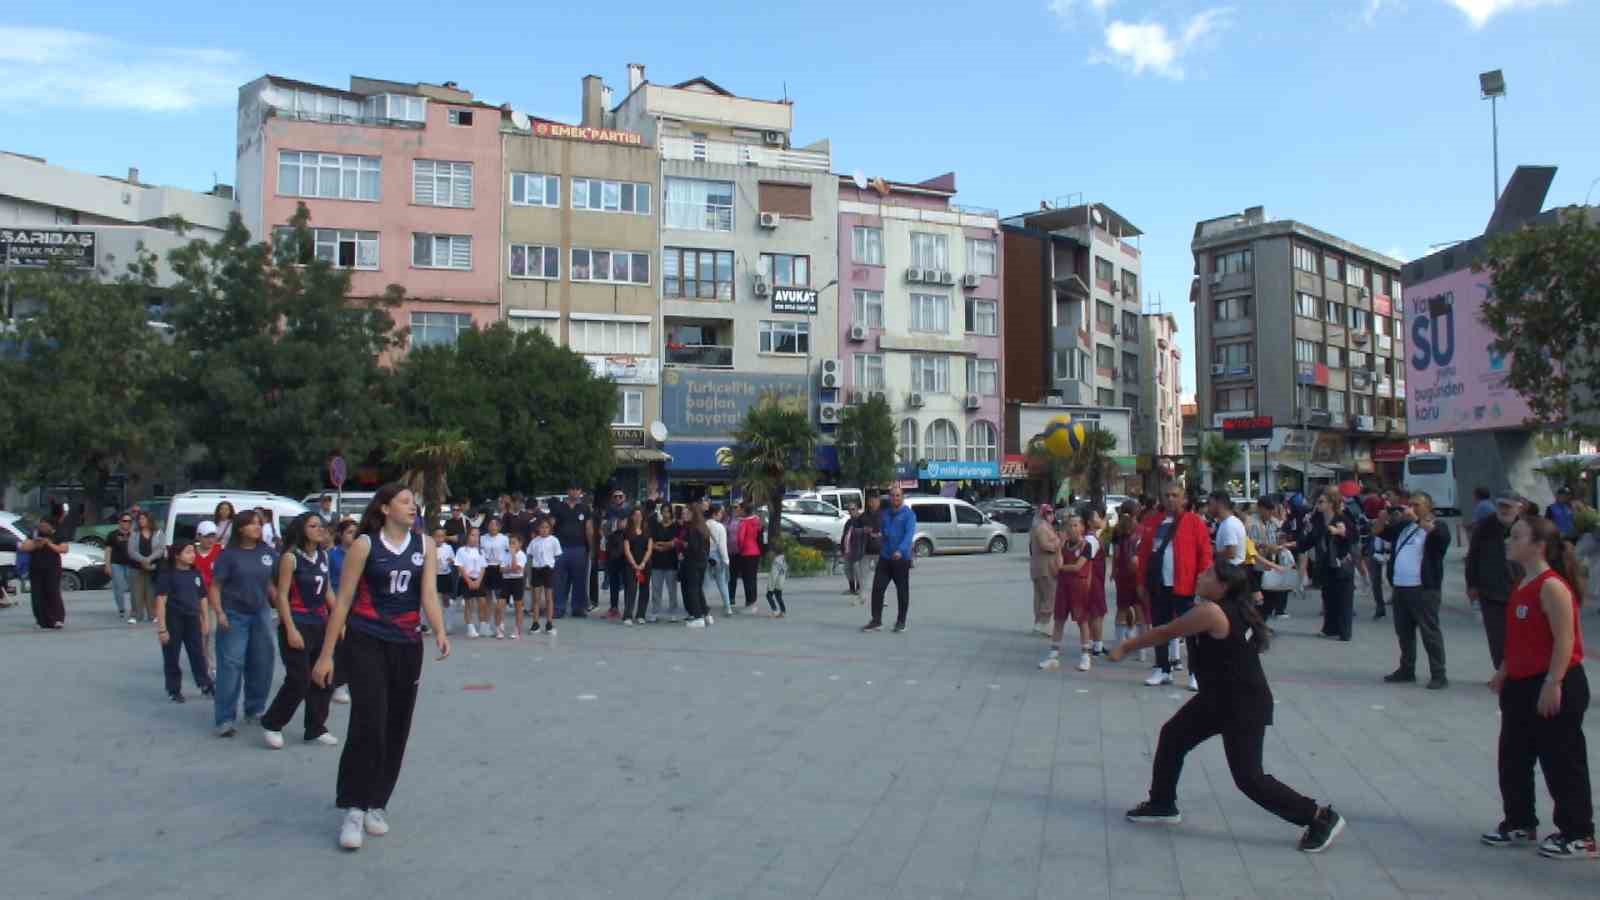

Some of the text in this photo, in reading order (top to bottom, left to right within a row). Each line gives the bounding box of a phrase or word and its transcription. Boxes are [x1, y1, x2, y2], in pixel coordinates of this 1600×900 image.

[551, 125, 585, 138] EMEK
[775, 290, 816, 303] AVUKAT
[1412, 303, 1454, 371] SU
[1415, 405, 1439, 421] koru
[314, 575, 324, 595] 7
[389, 569, 412, 594] 10
